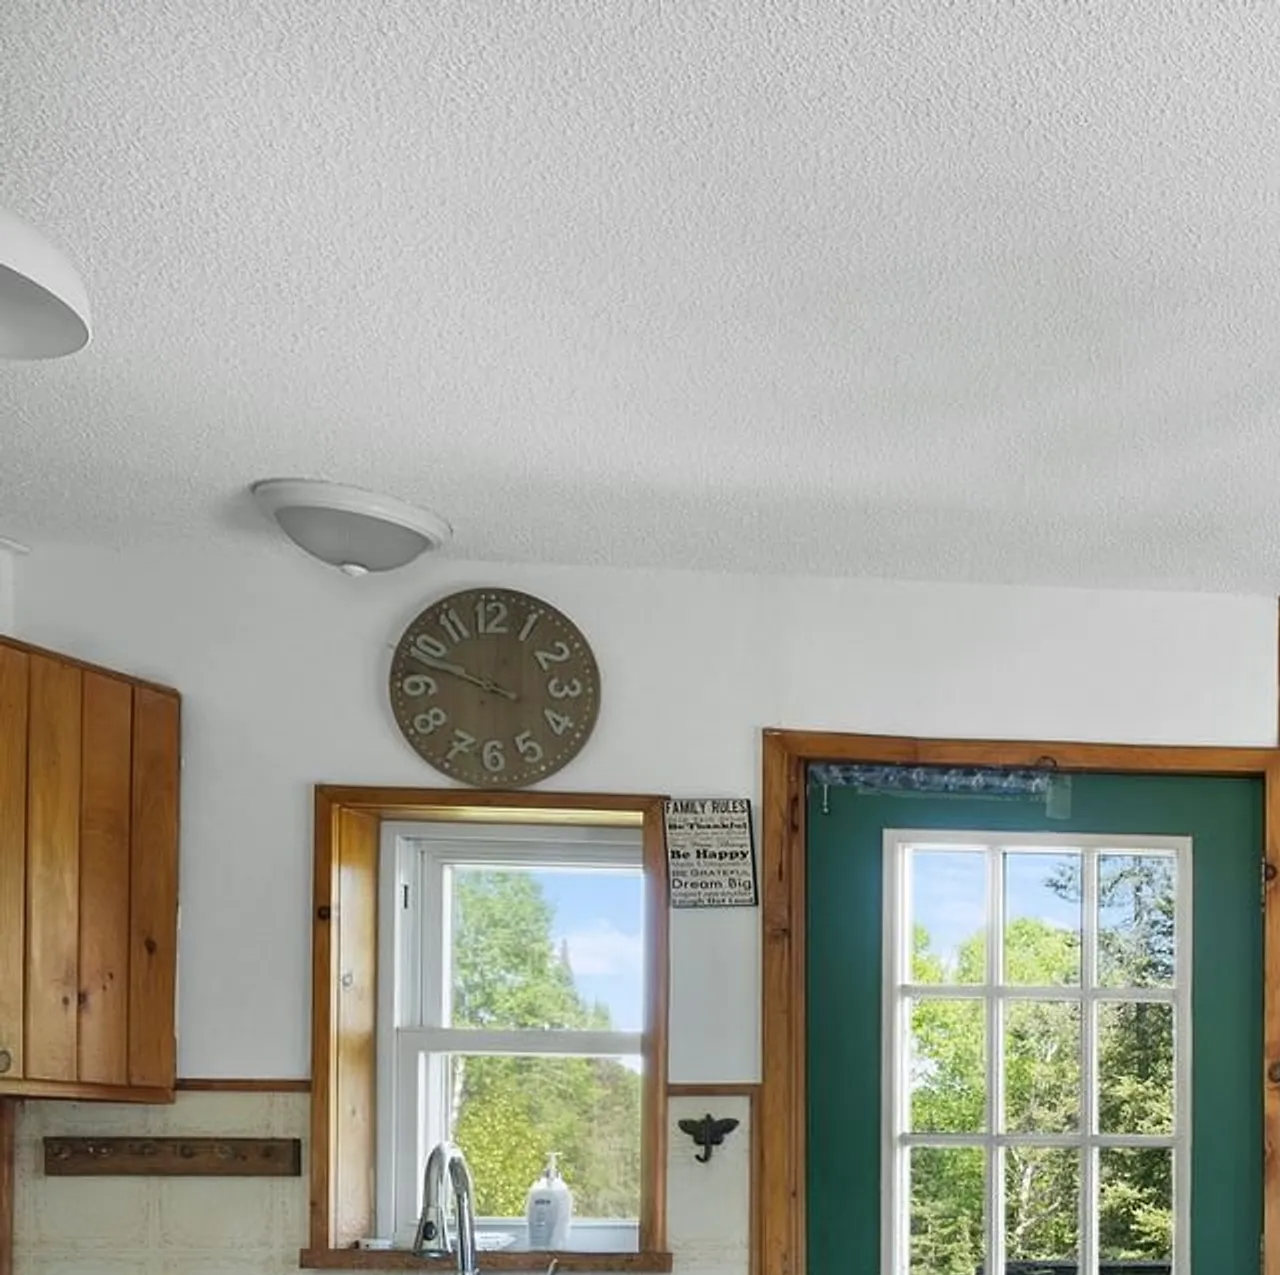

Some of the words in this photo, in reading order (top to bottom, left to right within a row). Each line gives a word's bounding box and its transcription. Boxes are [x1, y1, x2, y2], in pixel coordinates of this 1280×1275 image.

[440, 608, 470, 643] 11
[475, 601, 508, 634] 12
[519, 612, 540, 642] 1
[535, 641, 570, 671] 2
[403, 674, 437, 696] 9
[549, 678, 581, 699] 3
[413, 708, 447, 734] 8
[544, 708, 574, 735] 4
[447, 728, 476, 760] 7
[483, 740, 505, 772] 6
[515, 730, 544, 763] 5
[665, 801, 706, 815] FAMILY
[711, 801, 747, 814] RULES
[670, 849, 691, 859] Be
[696, 849, 749, 861] Happy
[672, 878, 724, 889] Dream
[728, 877, 752, 891] Big
